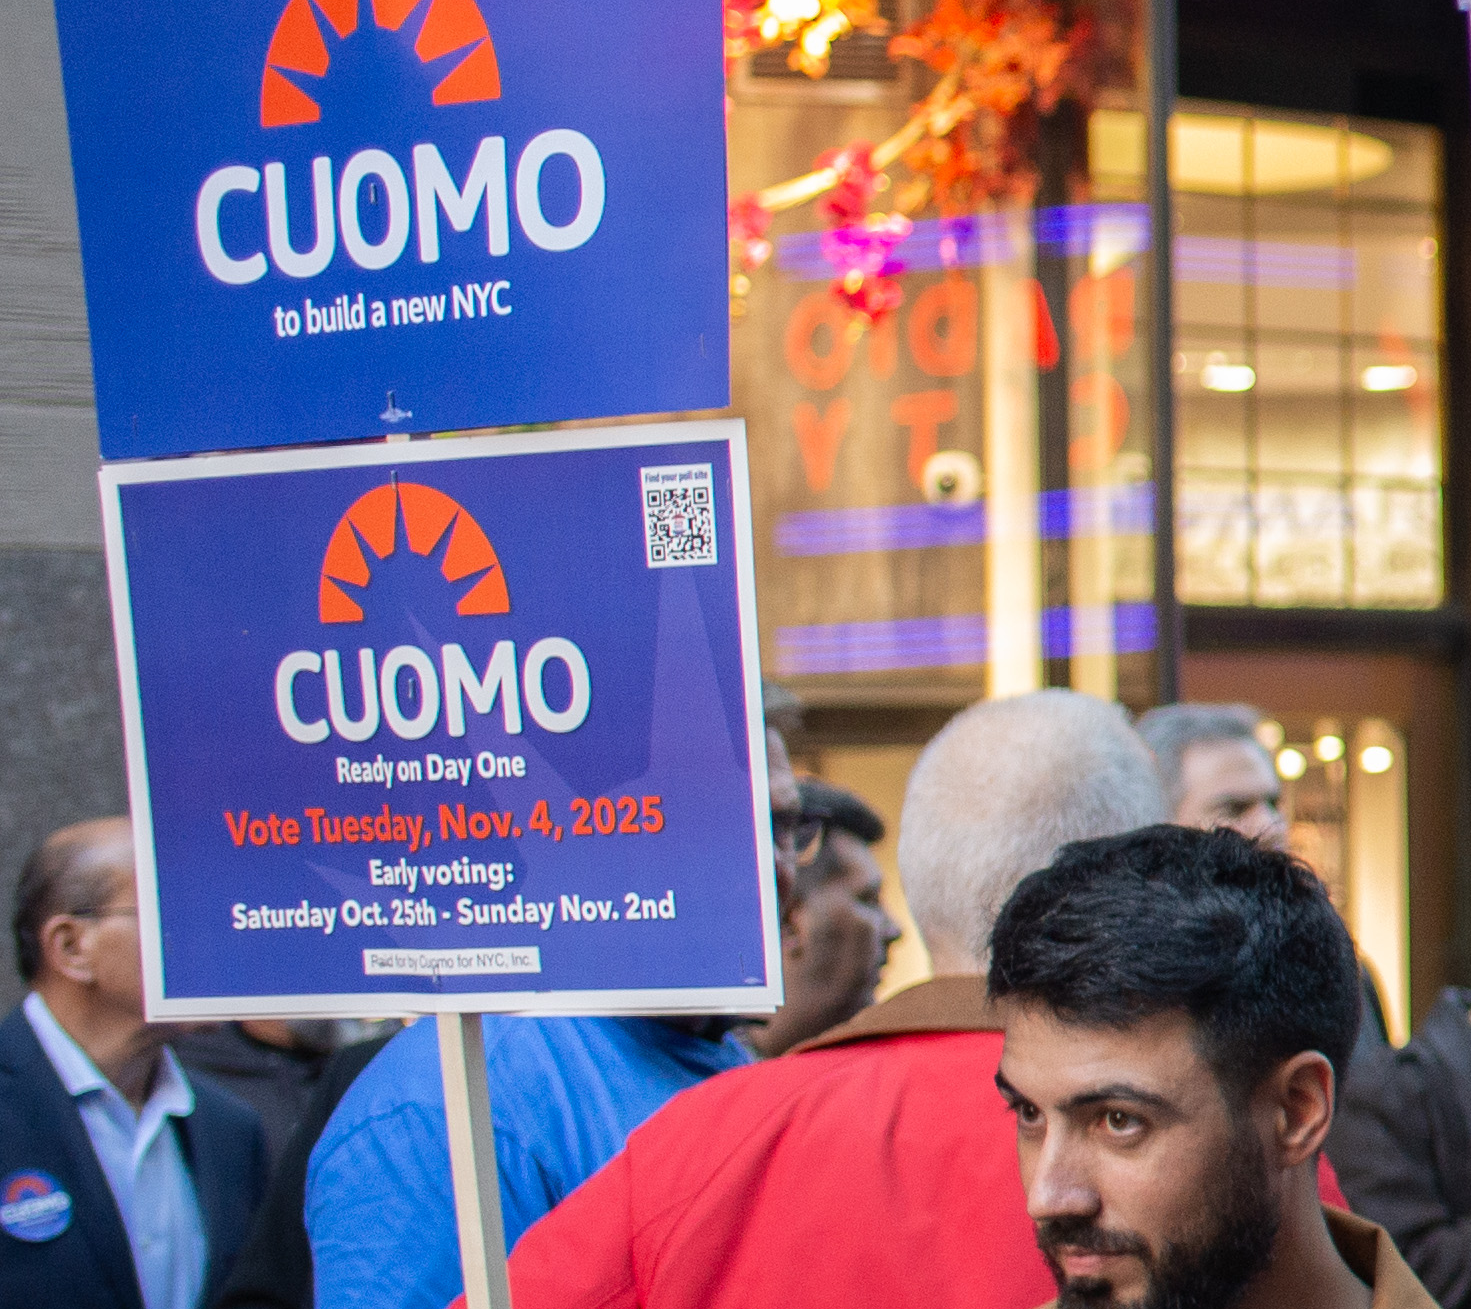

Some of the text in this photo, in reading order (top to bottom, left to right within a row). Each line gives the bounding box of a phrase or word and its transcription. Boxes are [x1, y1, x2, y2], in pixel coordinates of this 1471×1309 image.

[197, 128, 605, 285] CUOMO
[274, 280, 511, 337] to build a new NYC
[276, 637, 589, 743] CUOMO
[336, 751, 525, 789] Ready on Day One
[224, 796, 664, 852] Vote Tuesday, Nov. 4, 2025
[369, 856, 513, 893] Early voting:
[232, 900, 336, 934] Saturday
[342, 899, 388, 927] Oct.
[391, 898, 436, 926] 25th
[457, 895, 554, 930] Sunday
[562, 894, 619, 921] Nov.
[624, 890, 675, 920] 2nd
